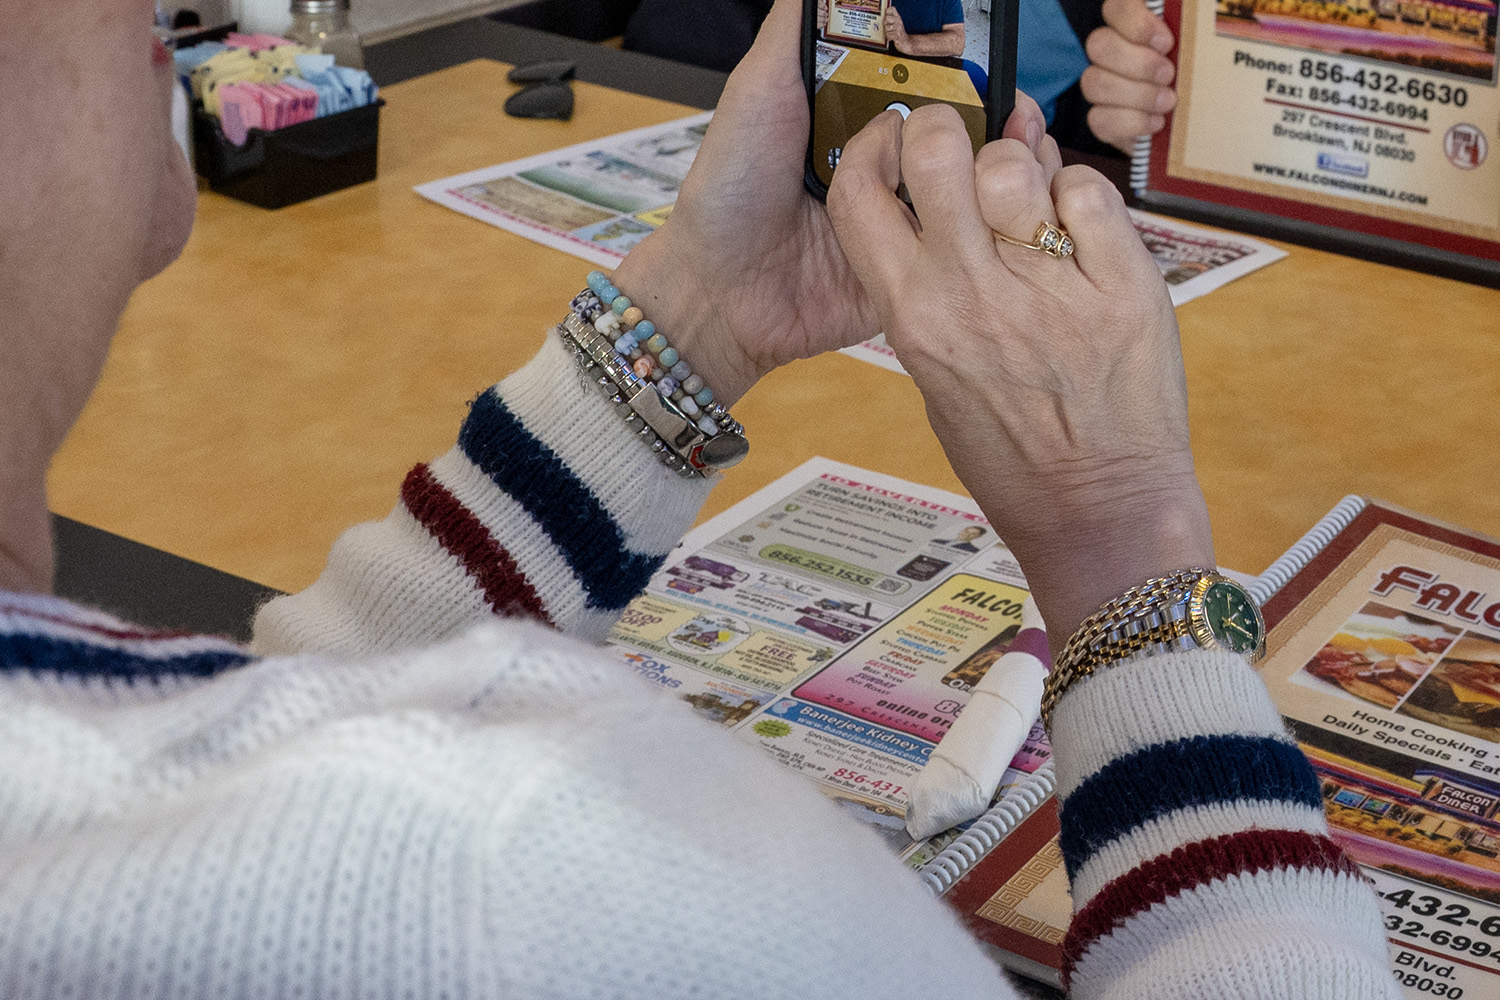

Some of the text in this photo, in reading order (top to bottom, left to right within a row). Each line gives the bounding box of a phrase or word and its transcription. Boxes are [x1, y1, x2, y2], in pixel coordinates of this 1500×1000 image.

[1233, 50, 1468, 107] Phone: 856-432-6630
[1265, 77, 1430, 122] Fax: 856-432-6994
[1309, 114, 1369, 137] Crescent
[939, 603, 990, 624] MONDAY
[759, 644, 798, 661] FREE
[896, 636, 949, 657] THURSDAY
[864, 658, 917, 680] SATURDAY
[887, 649, 926, 667] FRIDAY
[854, 671, 898, 690] SUNDAY
[876, 699, 929, 721] online
[799, 705, 866, 735] Banerjee
[866, 725, 922, 756] Kidney
[1321, 713, 1370, 737] Daily
[1372, 729, 1452, 762] Specials
[1351, 709, 1407, 735] Home
[1410, 727, 1489, 761] Cooking
[867, 751, 909, 771] Treatment
[833, 767, 909, 798] 856-431-
[1436, 795, 1481, 815] DINER
[1440, 784, 1493, 808] FALCON
[1394, 951, 1457, 981] Blvd.
